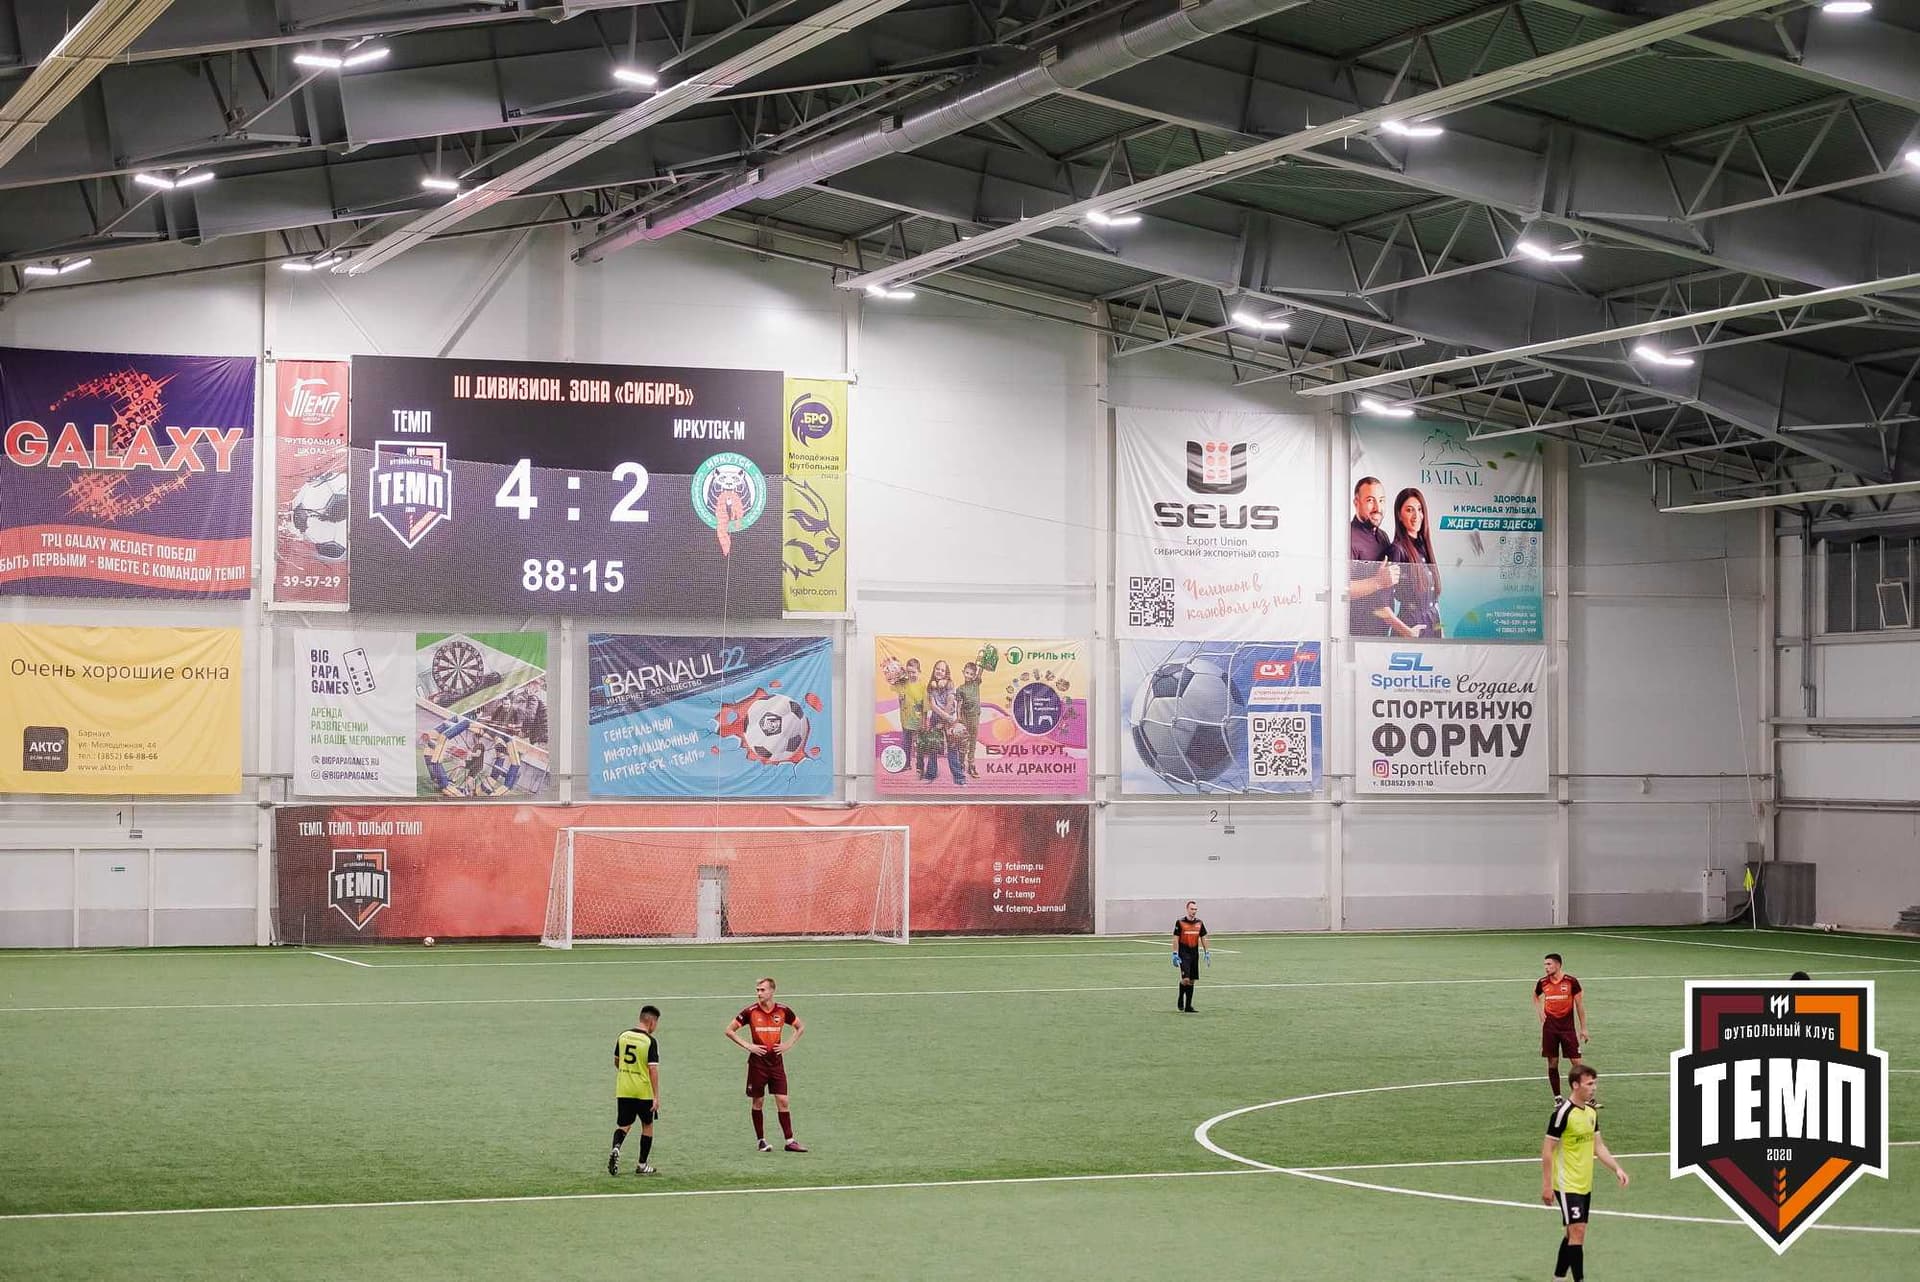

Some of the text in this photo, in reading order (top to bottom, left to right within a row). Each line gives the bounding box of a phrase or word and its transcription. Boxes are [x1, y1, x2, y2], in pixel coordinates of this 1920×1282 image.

[474, 376, 565, 401] ДИВИЗИОН.
[570, 379, 610, 403] ЗОНА
[614, 381, 694, 406] «СИБИРЬ»
[392, 410, 431, 433] ТЕМП
[673, 419, 745, 440] ИРКУТСК-М
[4, 420, 244, 472] GALAXY
[284, 437, 341, 447] ФУТБОЛЬНАЯ
[296, 447, 327, 455] ШКОЛА
[706, 454, 754, 468] ИРКУТСК
[789, 462, 839, 472] футбольная
[1421, 469, 1484, 486] BAIKAL
[378, 472, 443, 508] ТЕМП
[495, 459, 538, 520] 4
[609, 461, 650, 522] 2
[1494, 495, 1537, 504] ЗДОРОВАЯ
[1153, 502, 1280, 530] SEUS
[1453, 505, 1537, 515] И КРАСИВАЯ УЛЫБКА
[1447, 519, 1536, 531] ЖДЕТ ТЕБЯ ЗДЕСЬ!
[41, 533, 197, 562] ТРЦ GALAXY ЖЕЛАЕТ ПОБЕД!
[1186, 536, 1248, 547] Export Union
[1154, 547, 1201, 557] СИБИРСКИЙ
[1203, 549, 1256, 559] ЭКСПОРТНЫЙ
[32, 552, 87, 568] ПЕРВЫМИ
[97, 557, 140, 576] ВМЕСТЕ
[142, 563, 150, 576] С
[152, 564, 212, 583] КОМАНДОЙ
[215, 567, 246, 581] ТЕМП!
[282, 575, 341, 588] 39-57-29
[522, 558, 625, 594] 88:15
[1183, 578, 1249, 600] Чемпион
[1185, 585, 1303, 620] каждом из нас!
[310, 649, 329, 663] BIG
[1027, 652, 1059, 661] ГРИЛЬ
[11, 658, 230, 683] Очень хорошие окна
[311, 664, 340, 680] PAPA
[311, 679, 349, 695] GAMES
[1371, 673, 1451, 690] SportLife
[1456, 674, 1536, 699] Создаем
[311, 707, 343, 719] АРЕНДА
[1371, 699, 1533, 720] СПОРТИВНУЮ
[78, 729, 110, 739] Барнаул
[603, 715, 674, 742] ГЕНЕРАЛЬНЫЙ
[29, 741, 62, 753] АКТО
[311, 733, 406, 746] НА ВАШЕ МЕРОПРИЯТИЕ
[603, 729, 699, 764] ИНФОРМАЦИОННЫЙ
[1371, 723, 1532, 758] ФОРМУ
[986, 745, 1069, 757] БУДЬ КРУТ,
[321, 771, 379, 781] @BIGPAPAGAMES
[602, 761, 647, 783] ПАРТНЕР
[649, 757, 666, 772] ФК
[986, 763, 1077, 776] КАК ДРАКОН!
[1392, 760, 1487, 778] sportlifebrn
[116, 810, 122, 825] 1
[1210, 809, 1218, 823] 2
[299, 821, 423, 837] ТЕМП, ТЕМП, ТОЛЬКО ТЕМП!
[1005, 862, 1044, 873] fctemp.ru
[335, 871, 385, 899] ТЕМП
[1005, 875, 1041, 884] ФК Темп
[1005, 890, 1035, 900] fc.temp
[1005, 903, 1067, 914] fctemp_barnaul
[623, 1044, 638, 1065] 5
[1571, 1206, 1582, 1219] 3
